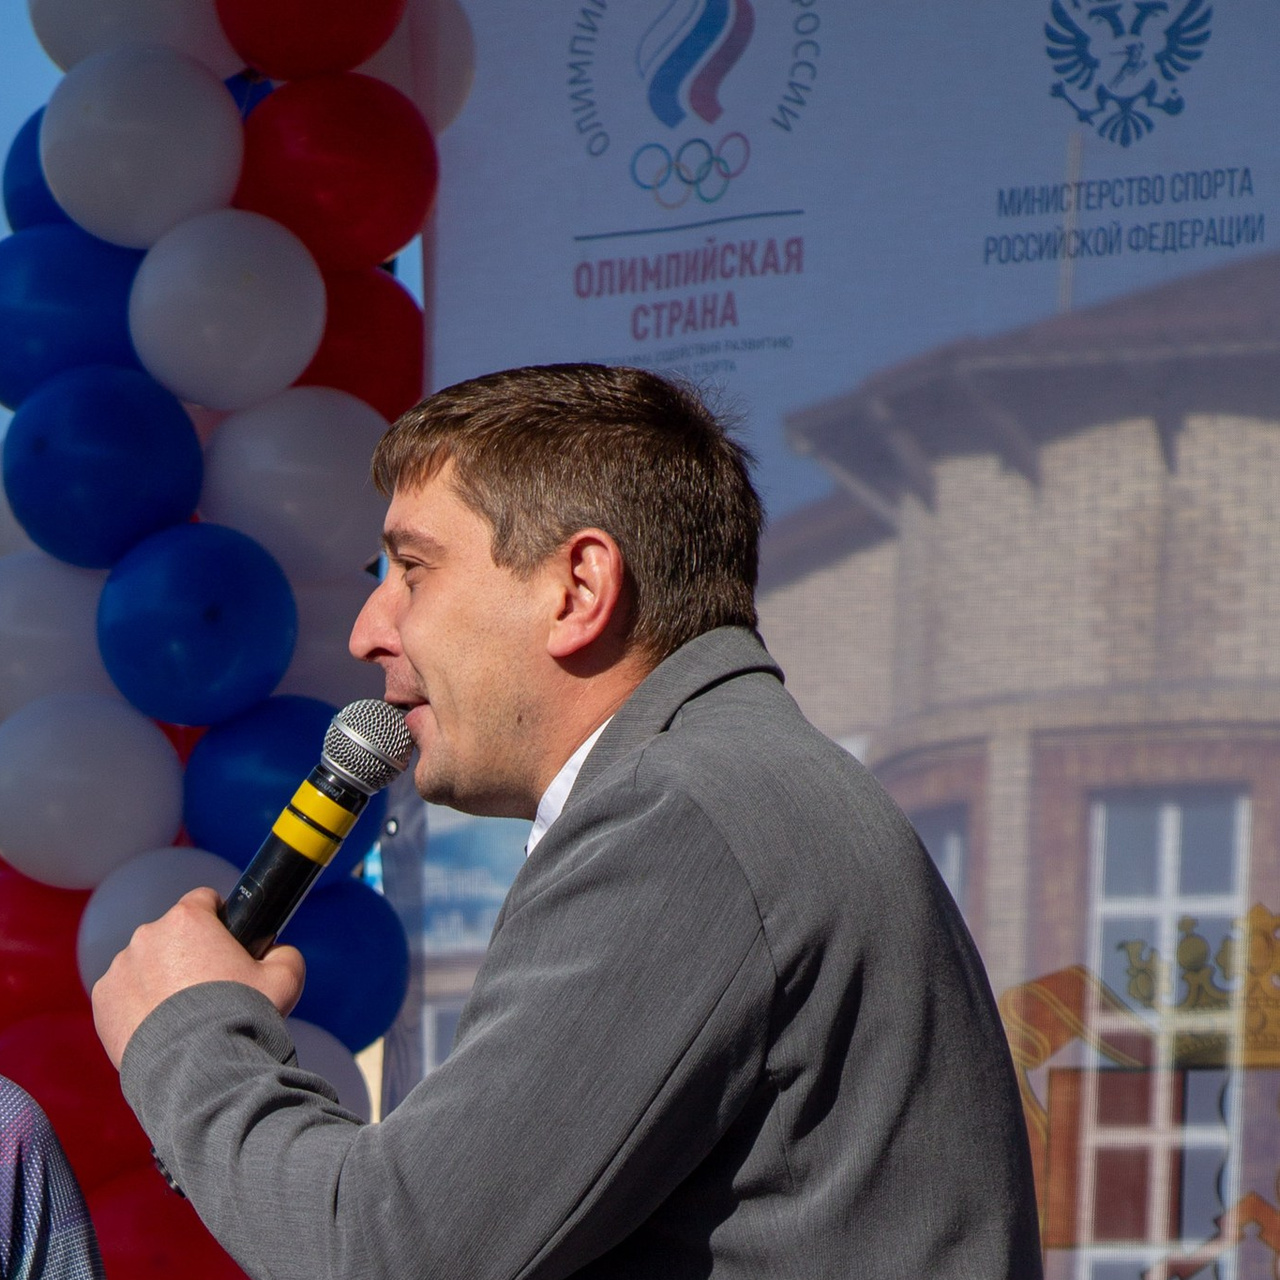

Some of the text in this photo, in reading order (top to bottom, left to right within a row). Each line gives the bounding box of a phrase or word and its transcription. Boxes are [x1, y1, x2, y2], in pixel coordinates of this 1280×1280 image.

[997, 167, 1253, 218] МИНИСТЕРСТВО СПОРТА
[984, 213, 1265, 265] РОССИЙСКОЙ ФЕДЕРАЦИИ
[574, 237, 805, 300] ОЛИМПИЙСКАЯ
[631, 291, 739, 342] СТРАНА
